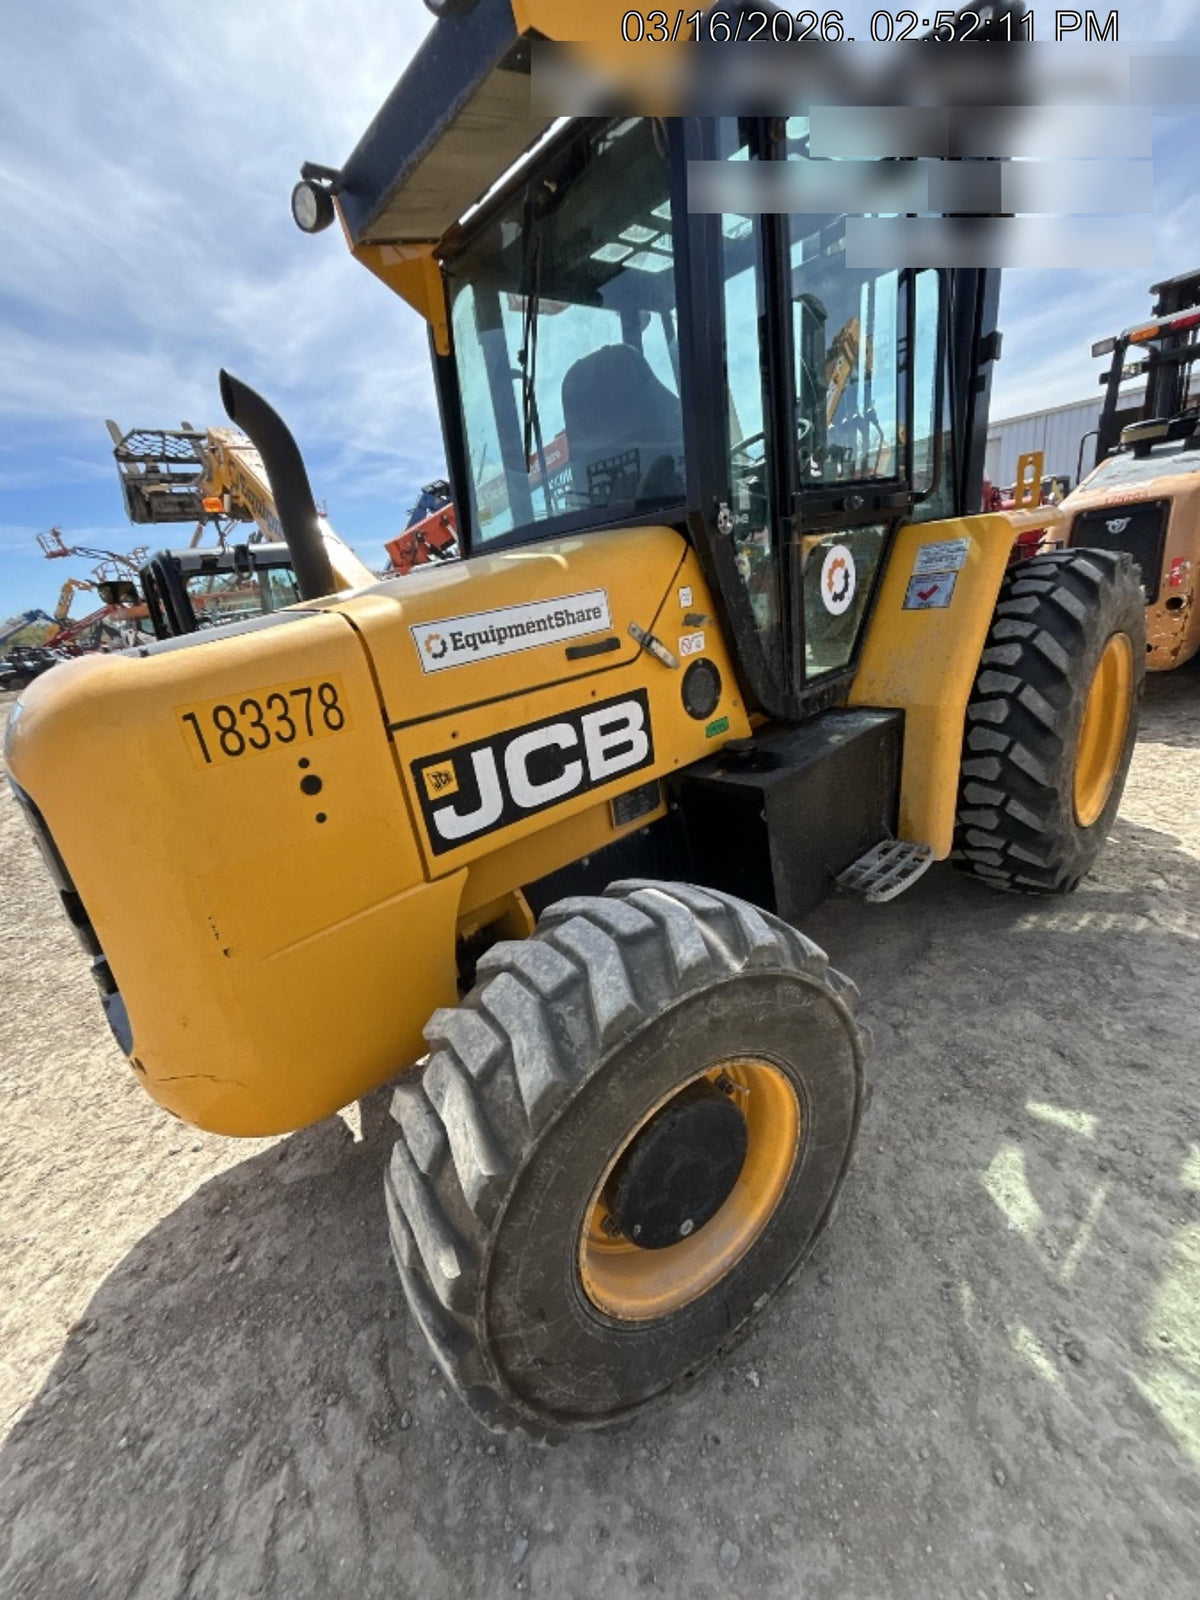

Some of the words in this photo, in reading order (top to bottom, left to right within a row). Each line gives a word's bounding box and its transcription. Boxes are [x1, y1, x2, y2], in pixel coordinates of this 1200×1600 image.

[450, 604, 602, 651] EquipmentShare
[182, 682, 345, 763] 183378
[433, 700, 649, 840] JCB
